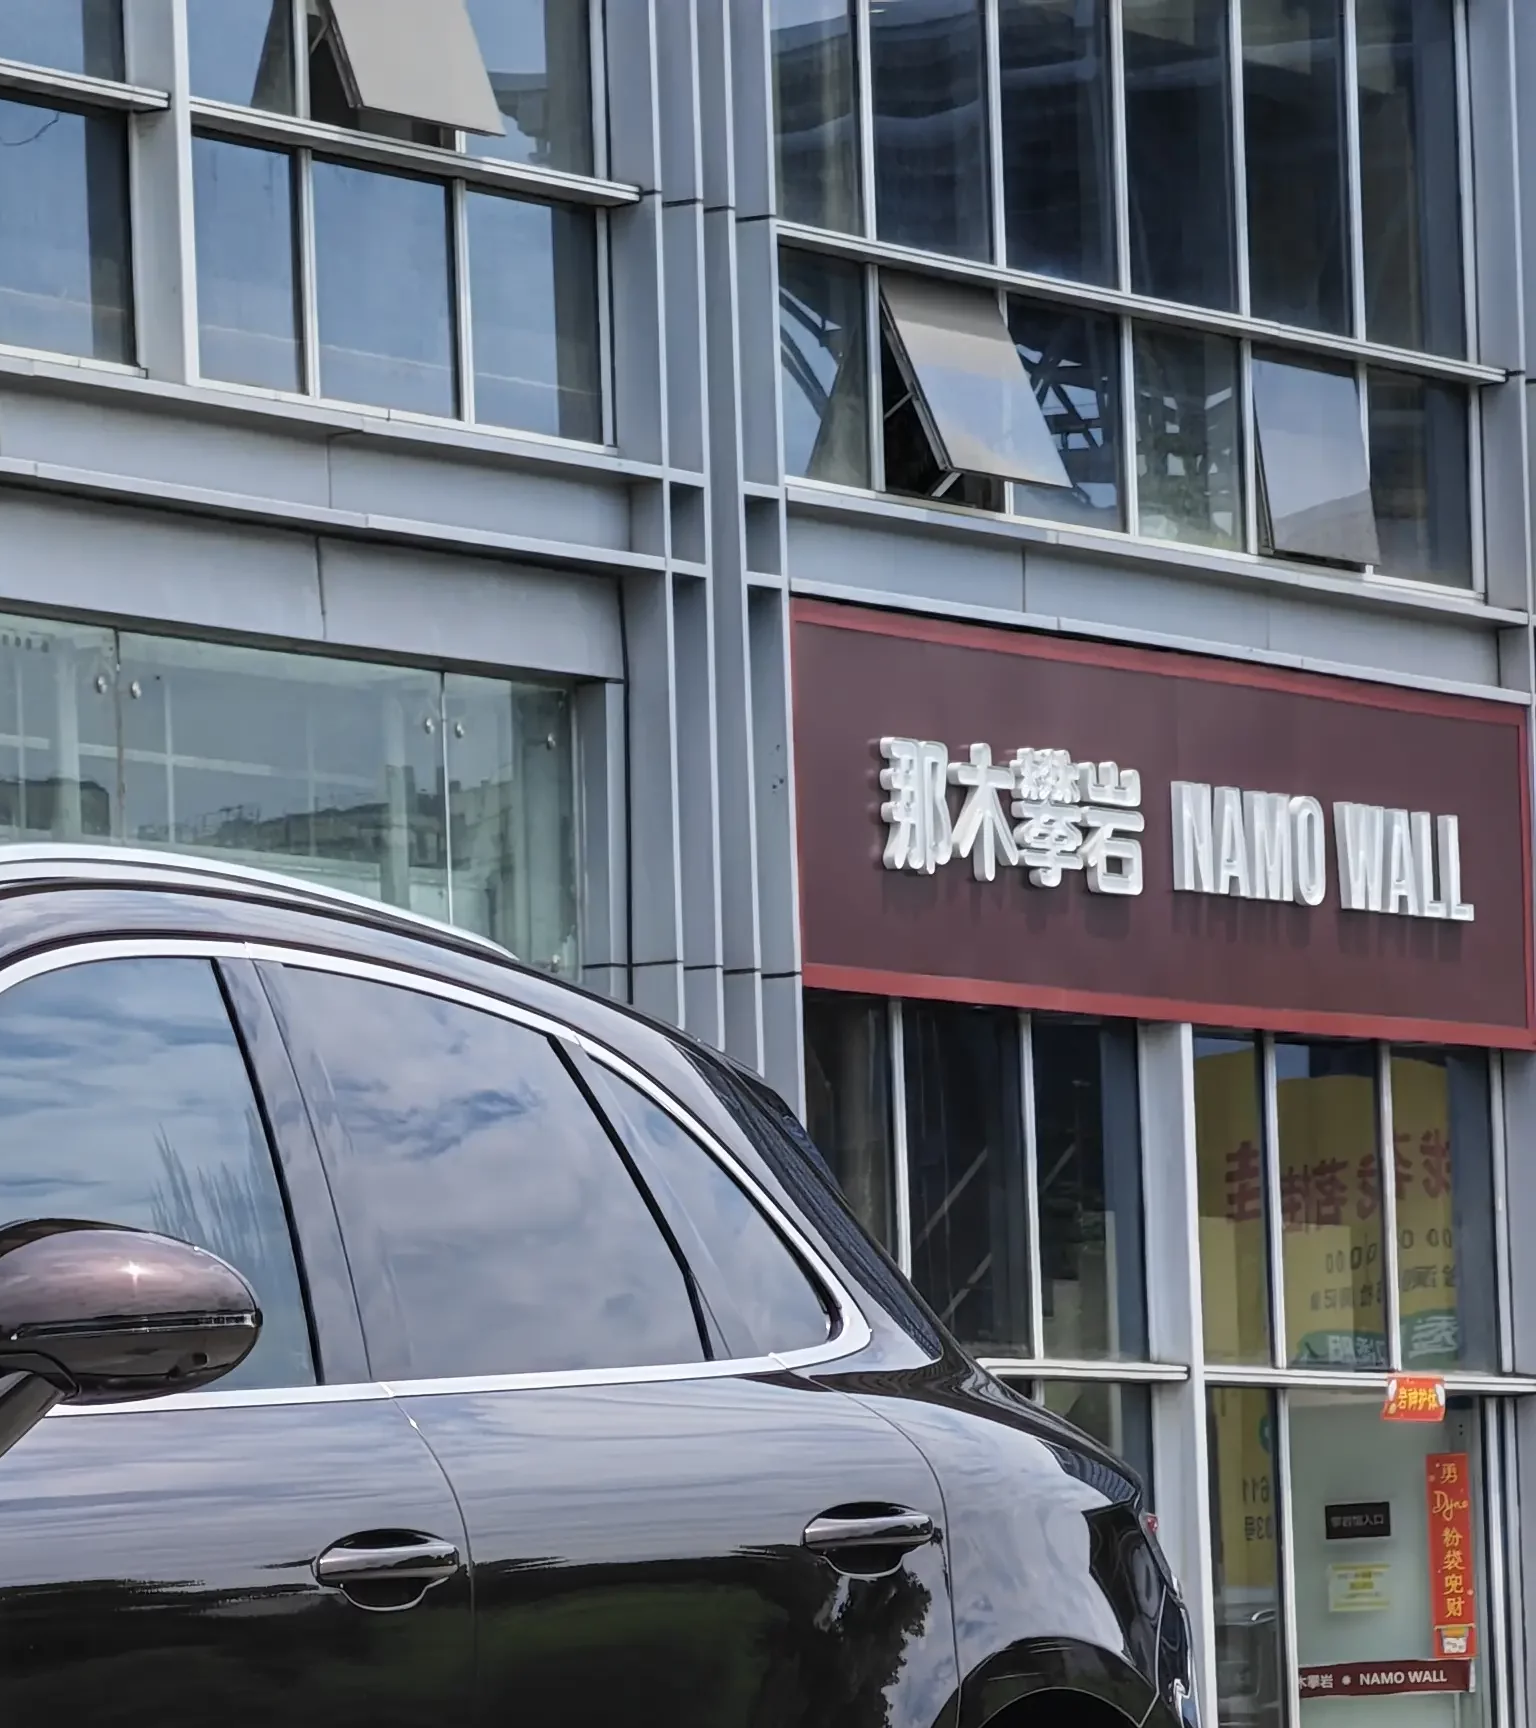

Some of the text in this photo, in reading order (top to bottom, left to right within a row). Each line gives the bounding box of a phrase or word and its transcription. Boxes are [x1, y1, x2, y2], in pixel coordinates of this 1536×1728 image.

[880, 736, 1145, 895] 那木攀岩
[1170, 780, 1475, 922] NAMO WALL
[1359, 1670, 1447, 1686] NAMO WALL
